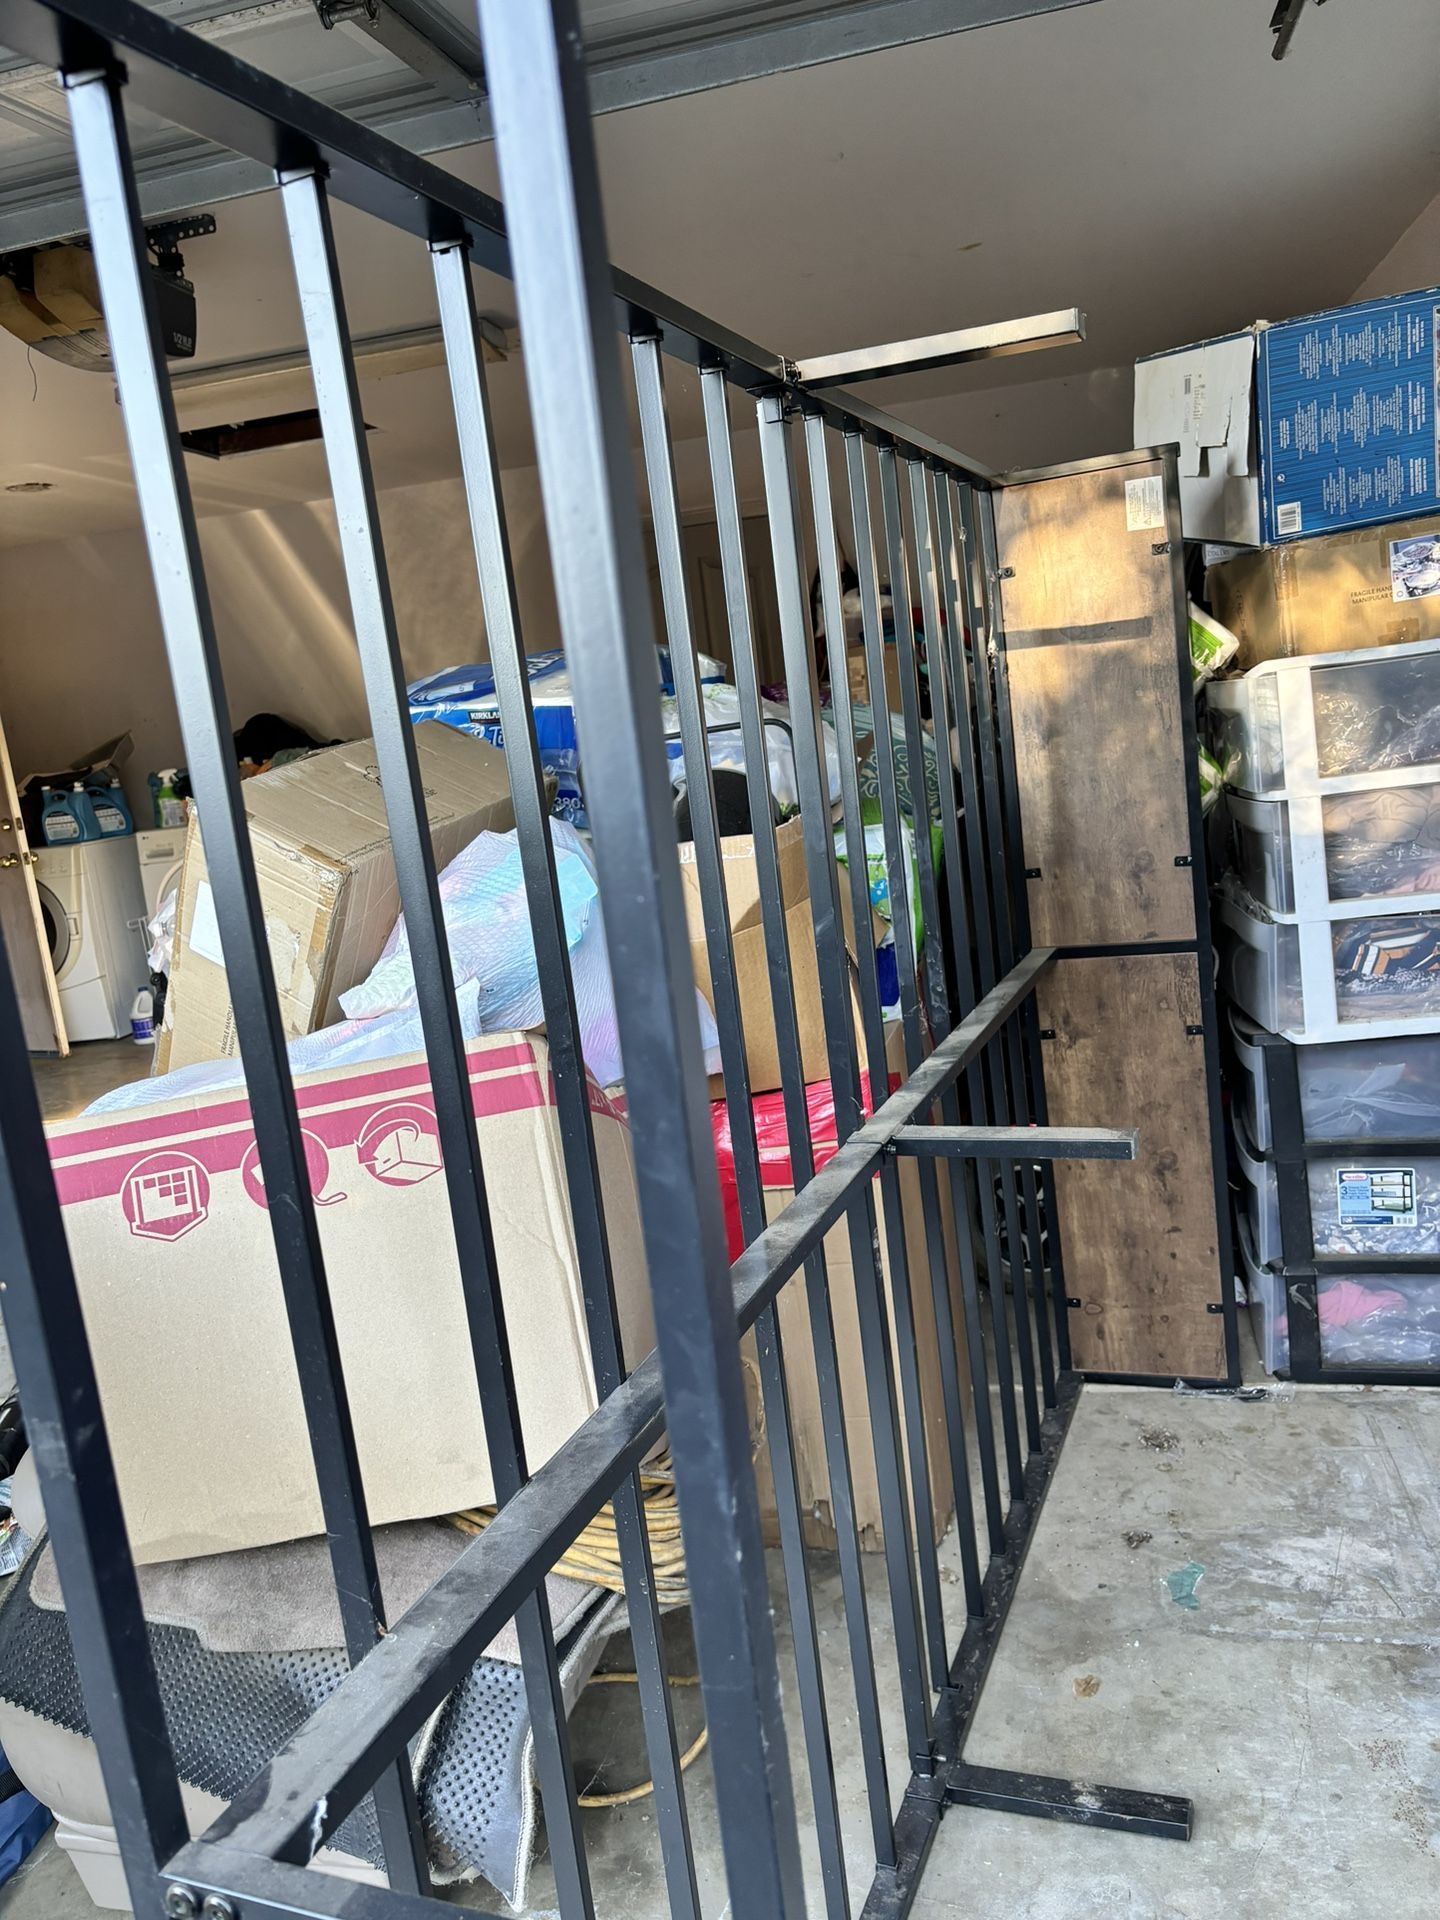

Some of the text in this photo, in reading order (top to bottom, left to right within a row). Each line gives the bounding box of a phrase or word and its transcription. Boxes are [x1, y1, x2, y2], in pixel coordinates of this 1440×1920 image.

[1350, 589, 1375, 598] FRAGILE
[1352, 593, 1389, 605] MANIPULAR
[220, 1030, 230, 1054] FRAGILE
[1340, 1185, 1348, 1195] 3
